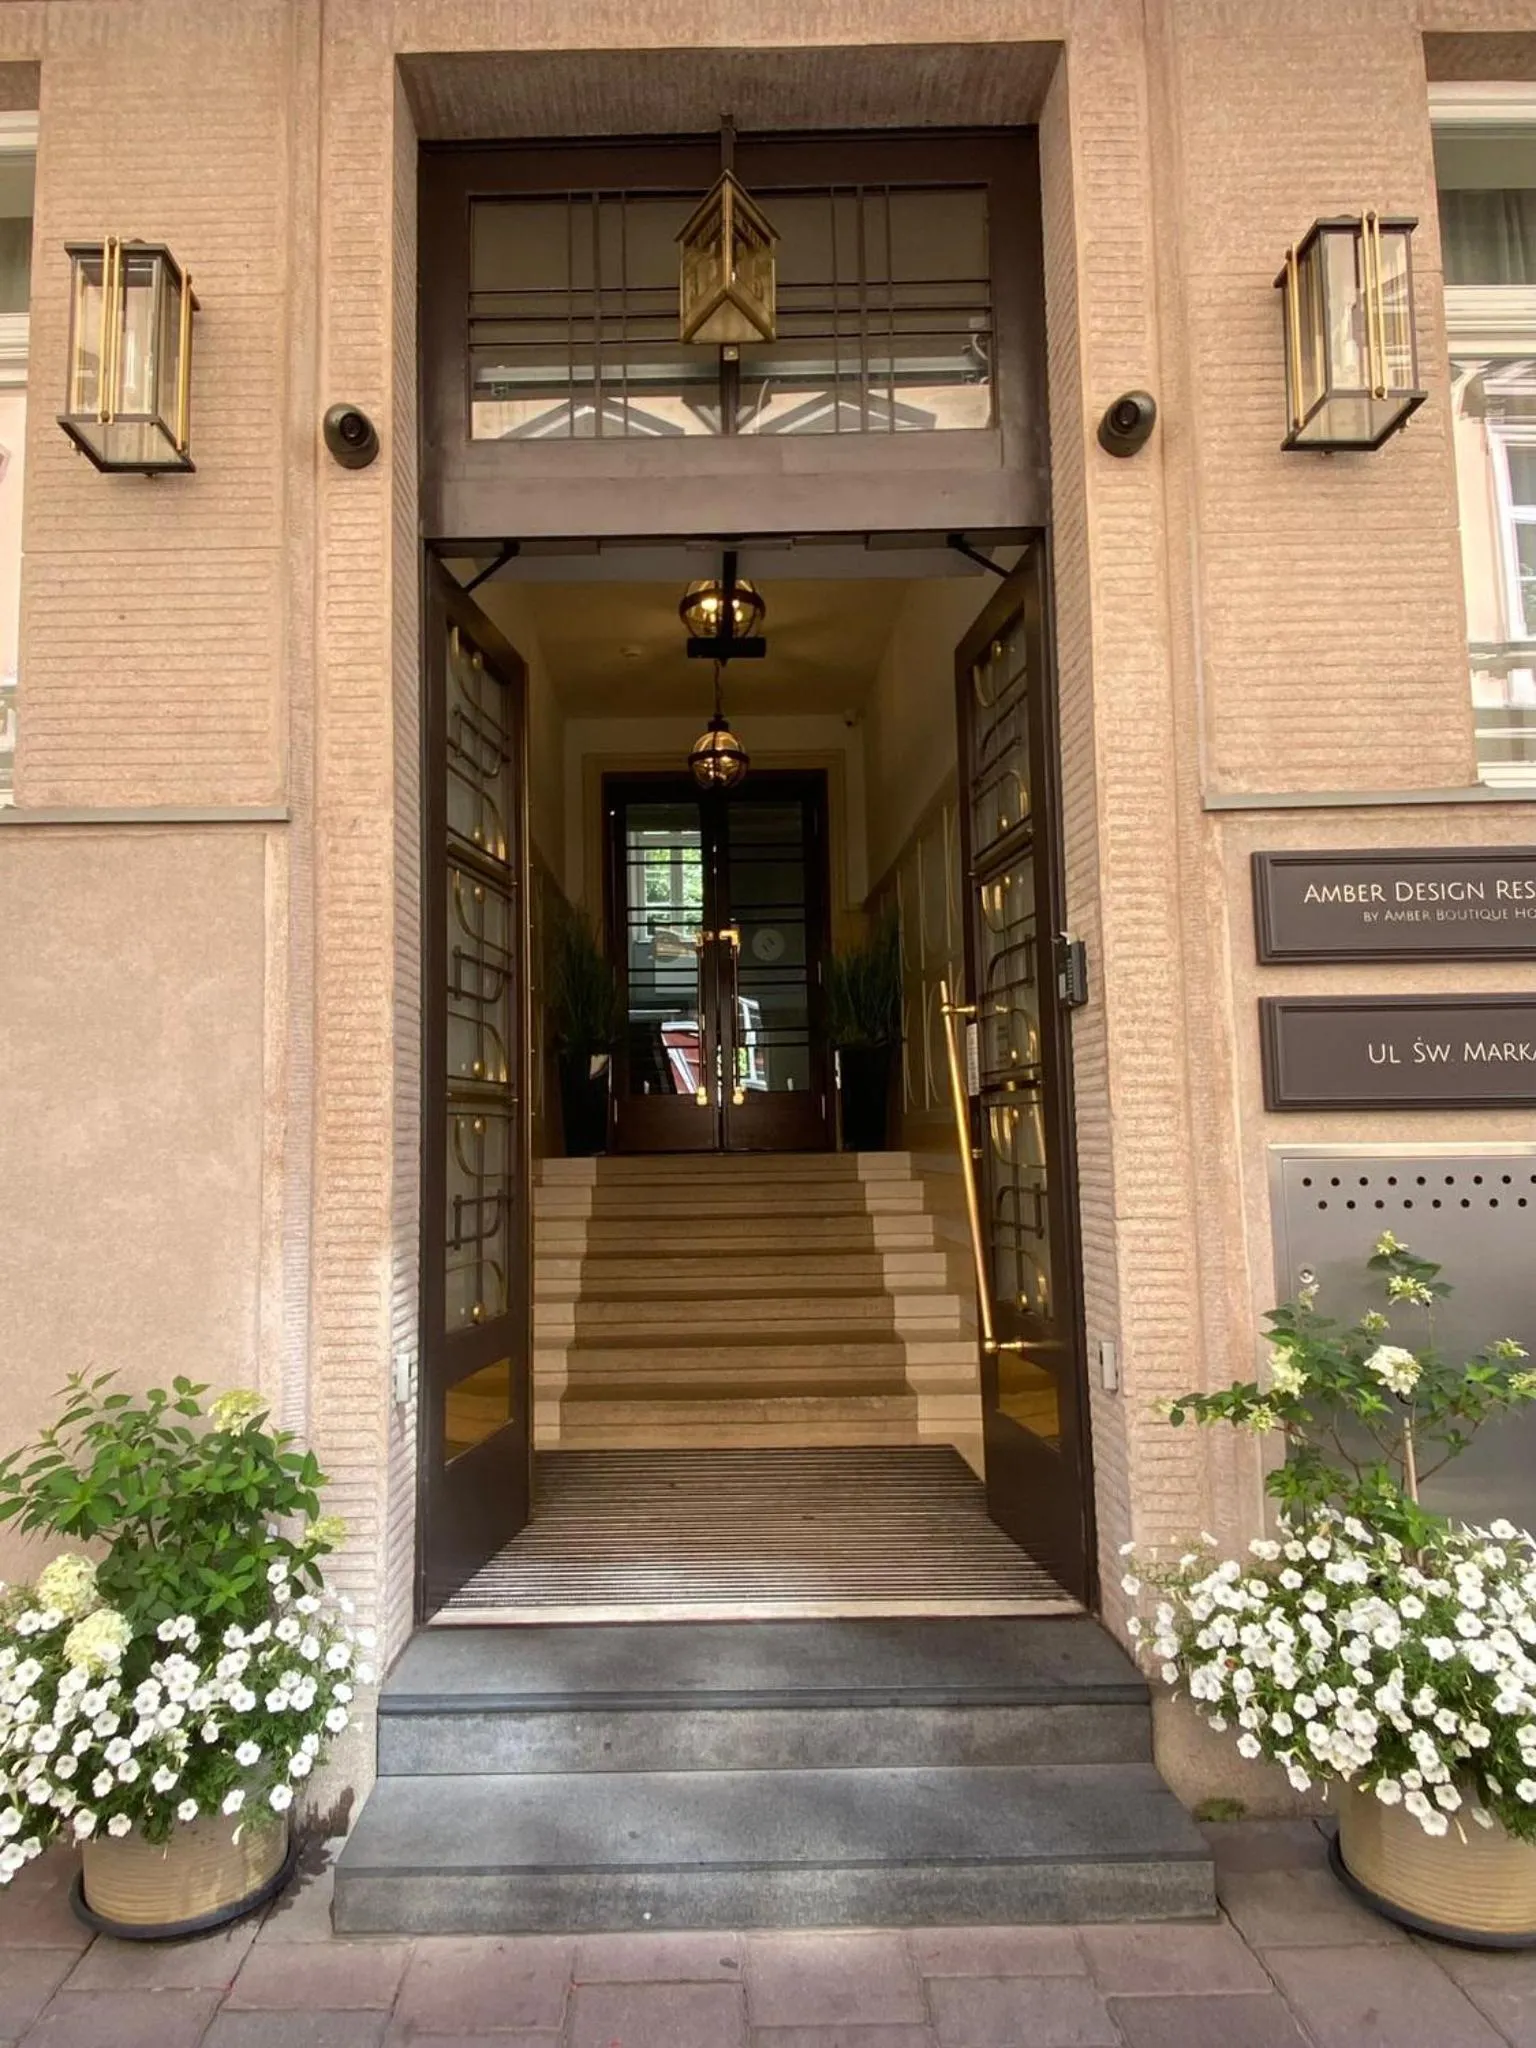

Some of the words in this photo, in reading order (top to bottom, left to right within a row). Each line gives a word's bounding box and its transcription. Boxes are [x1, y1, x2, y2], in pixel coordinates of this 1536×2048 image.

[1303, 883, 1387, 903] AMBER
[1394, 880, 1485, 902] DESIGN
[1495, 879, 1536, 900] RES
[1363, 911, 1379, 922] BY
[1384, 909, 1430, 921] AMBER
[1436, 908, 1508, 921] BOUTIQUE
[1368, 1043, 1402, 1064] UL
